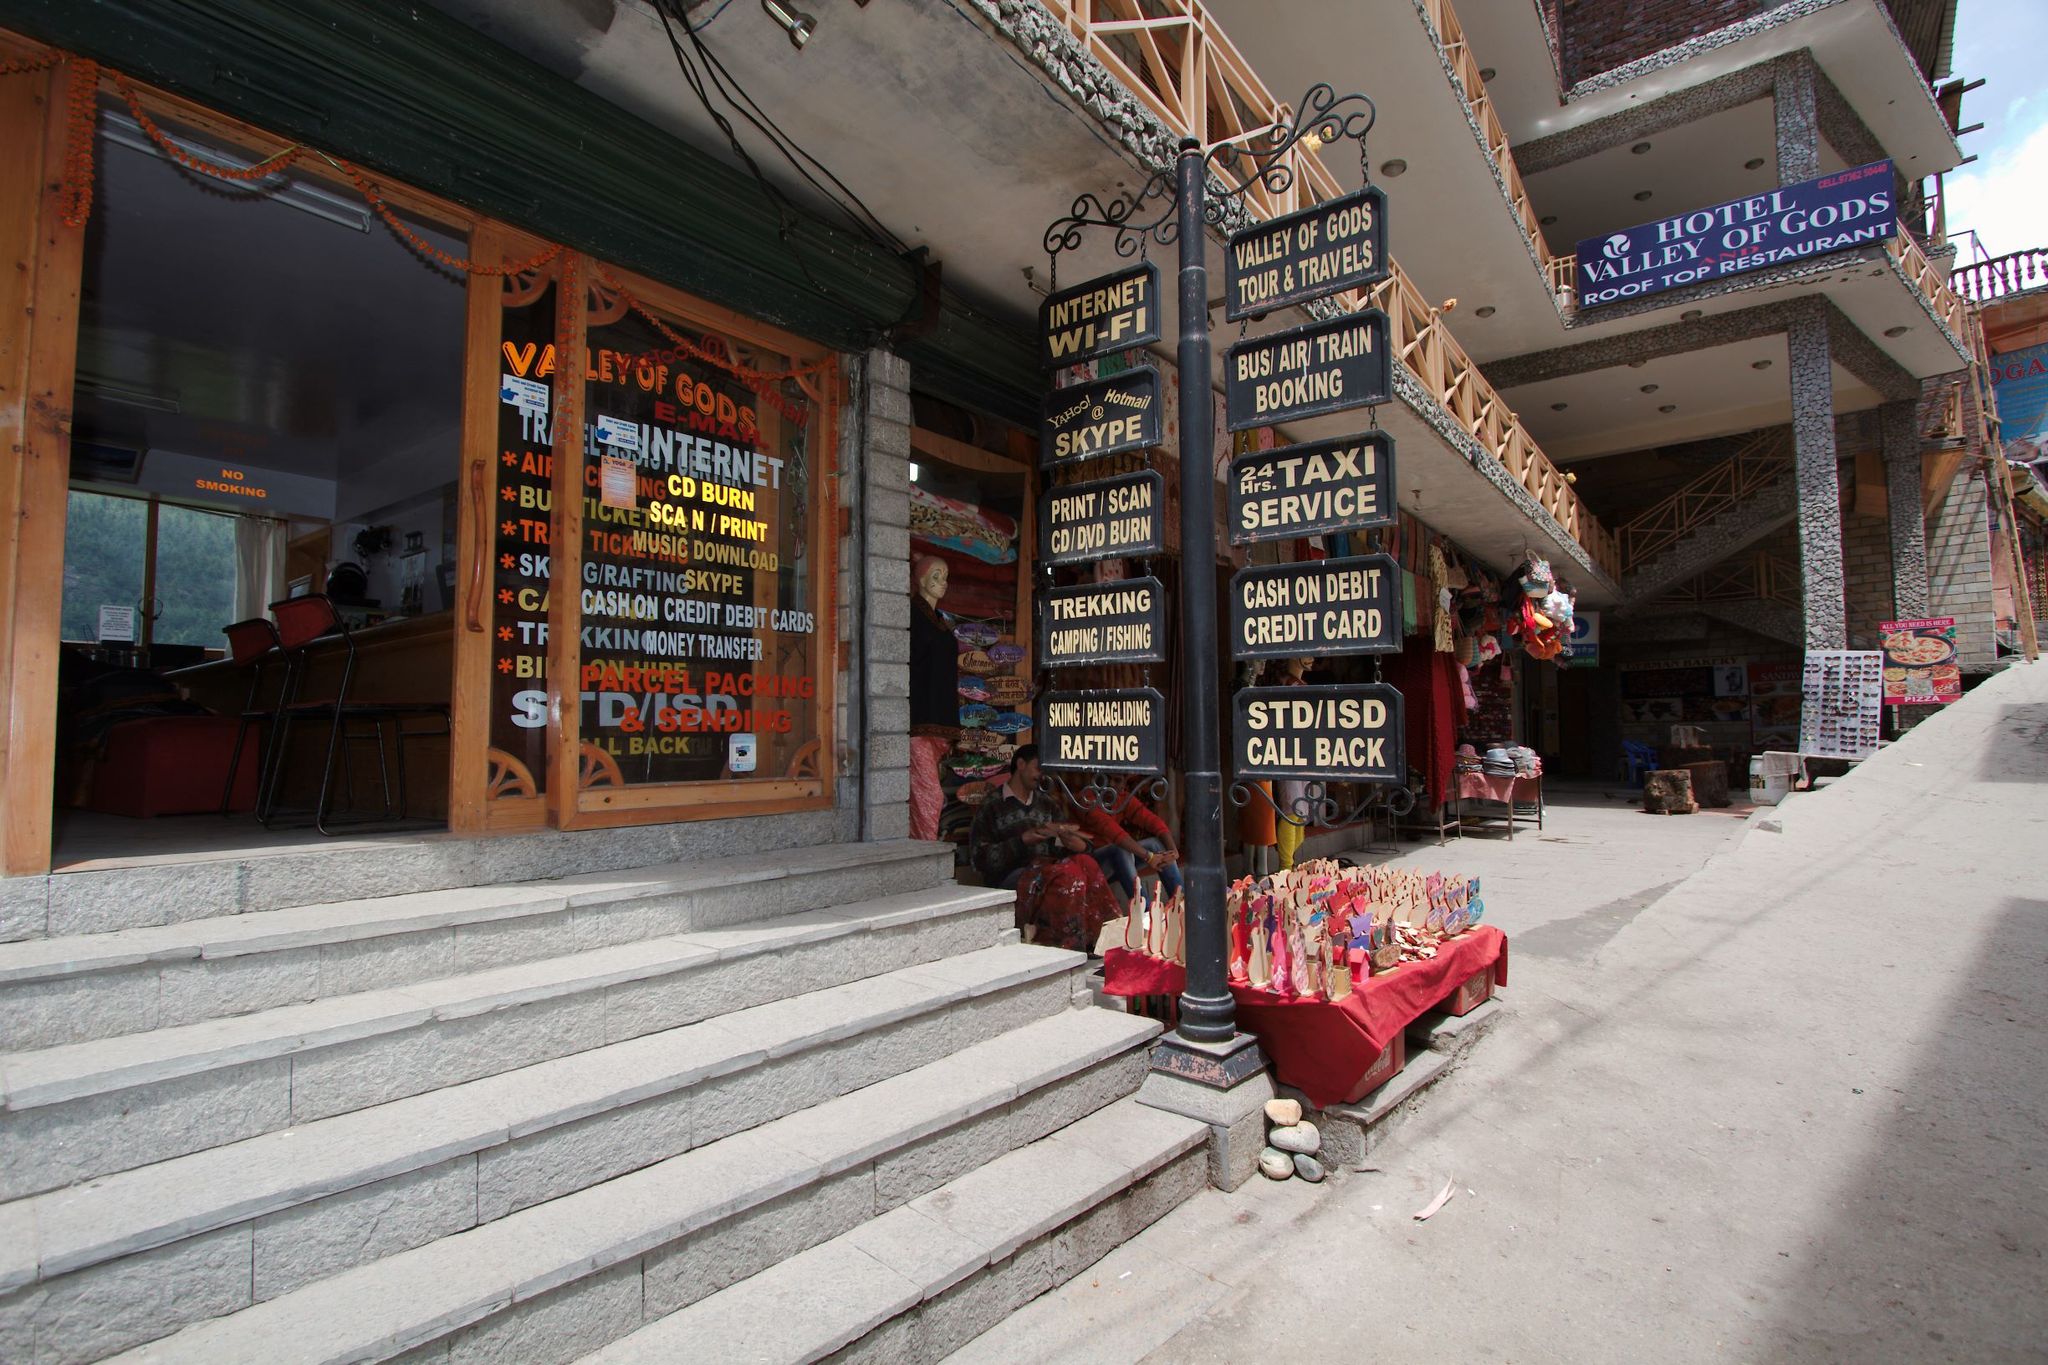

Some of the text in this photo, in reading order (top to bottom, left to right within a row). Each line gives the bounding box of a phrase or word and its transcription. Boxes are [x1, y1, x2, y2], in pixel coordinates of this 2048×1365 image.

[1236, 201, 1372, 270] VALLEY OF GODS
[1656, 190, 1797, 244] HOTEL
[1583, 190, 1890, 283] VALLEY OF GODS
[1238, 239, 1373, 304] TOUR & TRAVELS
[1584, 221, 1891, 305] ROOF TOP RESTAURANT
[1049, 274, 1148, 329] INTERNET
[1048, 307, 1146, 358] WI-FI
[1317, 325, 1372, 363] TRAIN
[636, 357, 669, 395] OF
[675, 373, 756, 434] GODS
[1092, 405, 1104, 420] @
[1104, 388, 1152, 409] Hotmail
[1256, 368, 1343, 413] BOOKING
[1055, 414, 1142, 457] SKYPE
[641, 423, 784, 489] INTERNET
[1240, 463, 1274, 482] 24
[1277, 445, 1375, 488] TAXI
[195, 479, 267, 498] SMOKING
[221, 469, 244, 481] NO
[667, 475, 696, 499] CD
[702, 482, 755, 512] BURN
[1240, 480, 1277, 495] Hrs.
[1051, 493, 1096, 524] PRINT
[1108, 482, 1151, 514] SCAN
[1241, 484, 1377, 530] SERVICE
[720, 515, 768, 542] PRINT
[1110, 515, 1151, 545] BURN
[633, 530, 778, 572] MUSIC DOWNLOAD
[685, 569, 743, 595] SKYPE
[1243, 569, 1381, 609] CASH ON DEBIT
[581, 589, 629, 617] CASH
[634, 594, 658, 620] ON
[664, 598, 720, 626] CREDIT
[726, 602, 767, 629] DEBIT
[770, 608, 814, 634] CARDS
[1050, 589, 1151, 620] TREKKING
[1050, 627, 1098, 656] CAMPING
[1106, 623, 1151, 651] FISHING
[1244, 608, 1382, 645] CREDIT CARD
[646, 631, 763, 661] MONEY TRANSFER
[581, 665, 816, 699] PARCEL PACKING
[1904, 695, 1940, 703] PIZZA
[620, 707, 792, 733] & SENDING
[1049, 702, 1080, 727] SKIING
[1087, 700, 1151, 726] PARAGLIDING
[1248, 699, 1387, 730] STD/ISD
[629, 736, 690, 755] BACK
[1060, 734, 1139, 761] RAFTING
[1247, 737, 1386, 768] CALL BACK
